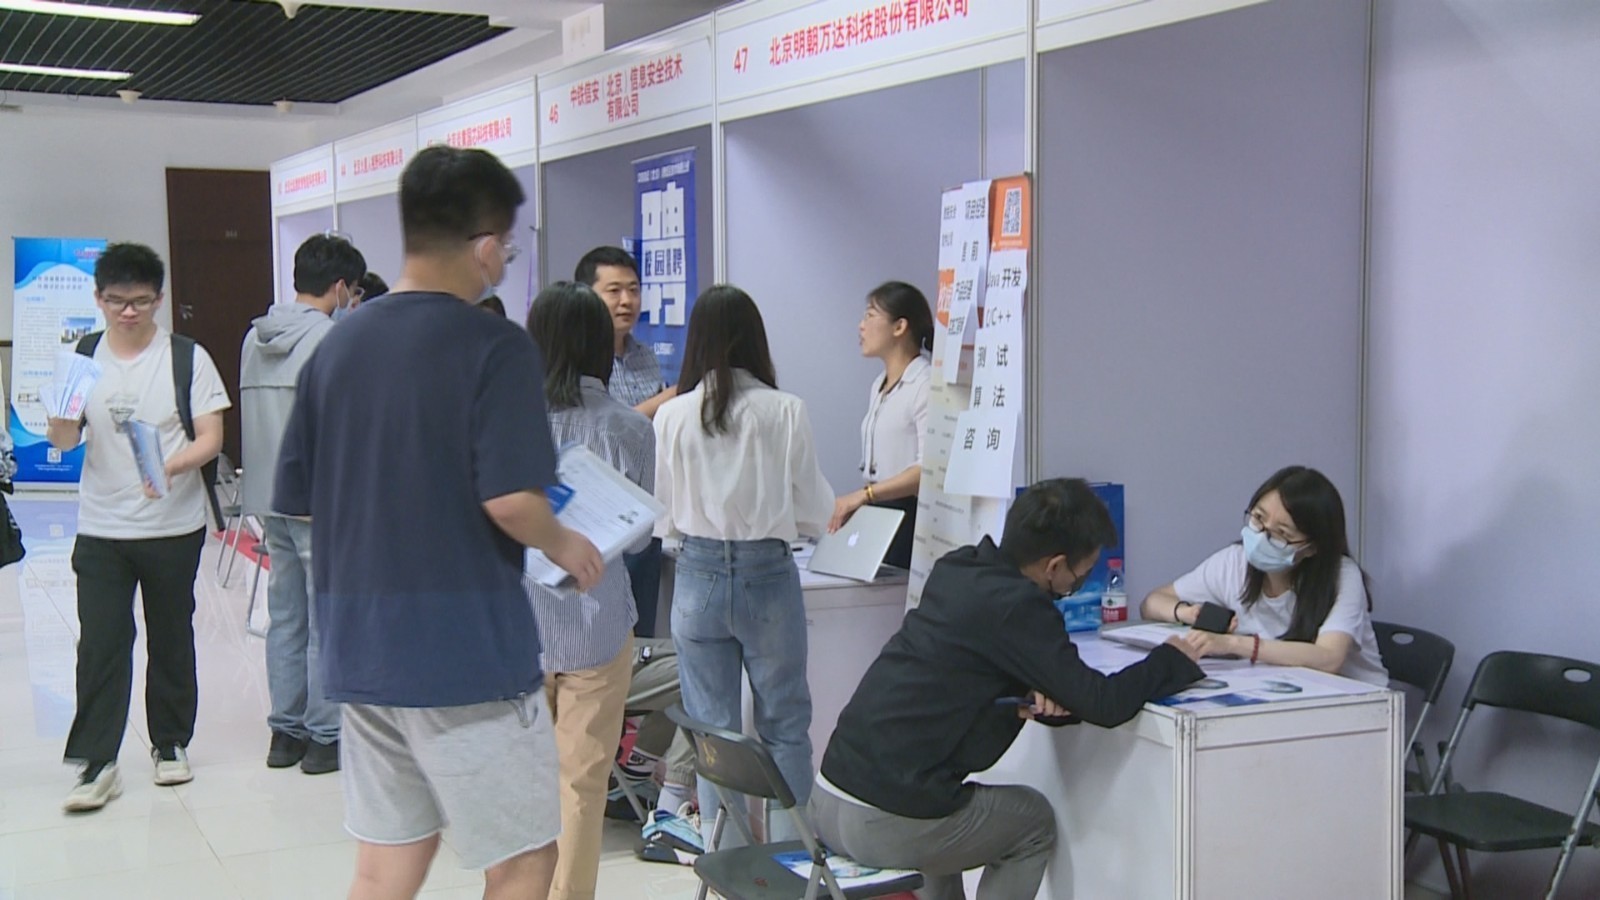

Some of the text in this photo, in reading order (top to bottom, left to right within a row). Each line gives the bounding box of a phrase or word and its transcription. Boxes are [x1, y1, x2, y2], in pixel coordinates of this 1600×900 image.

[733, 0, 968, 73] 47 北京明朝万达科技股份有限公司
[549, 103, 559, 124] 46
[606, 92, 639, 123] 有限公司
[977, 344, 1009, 368] 测试
[974, 384, 1005, 408] 算法
[963, 427, 1001, 451] 咨询
